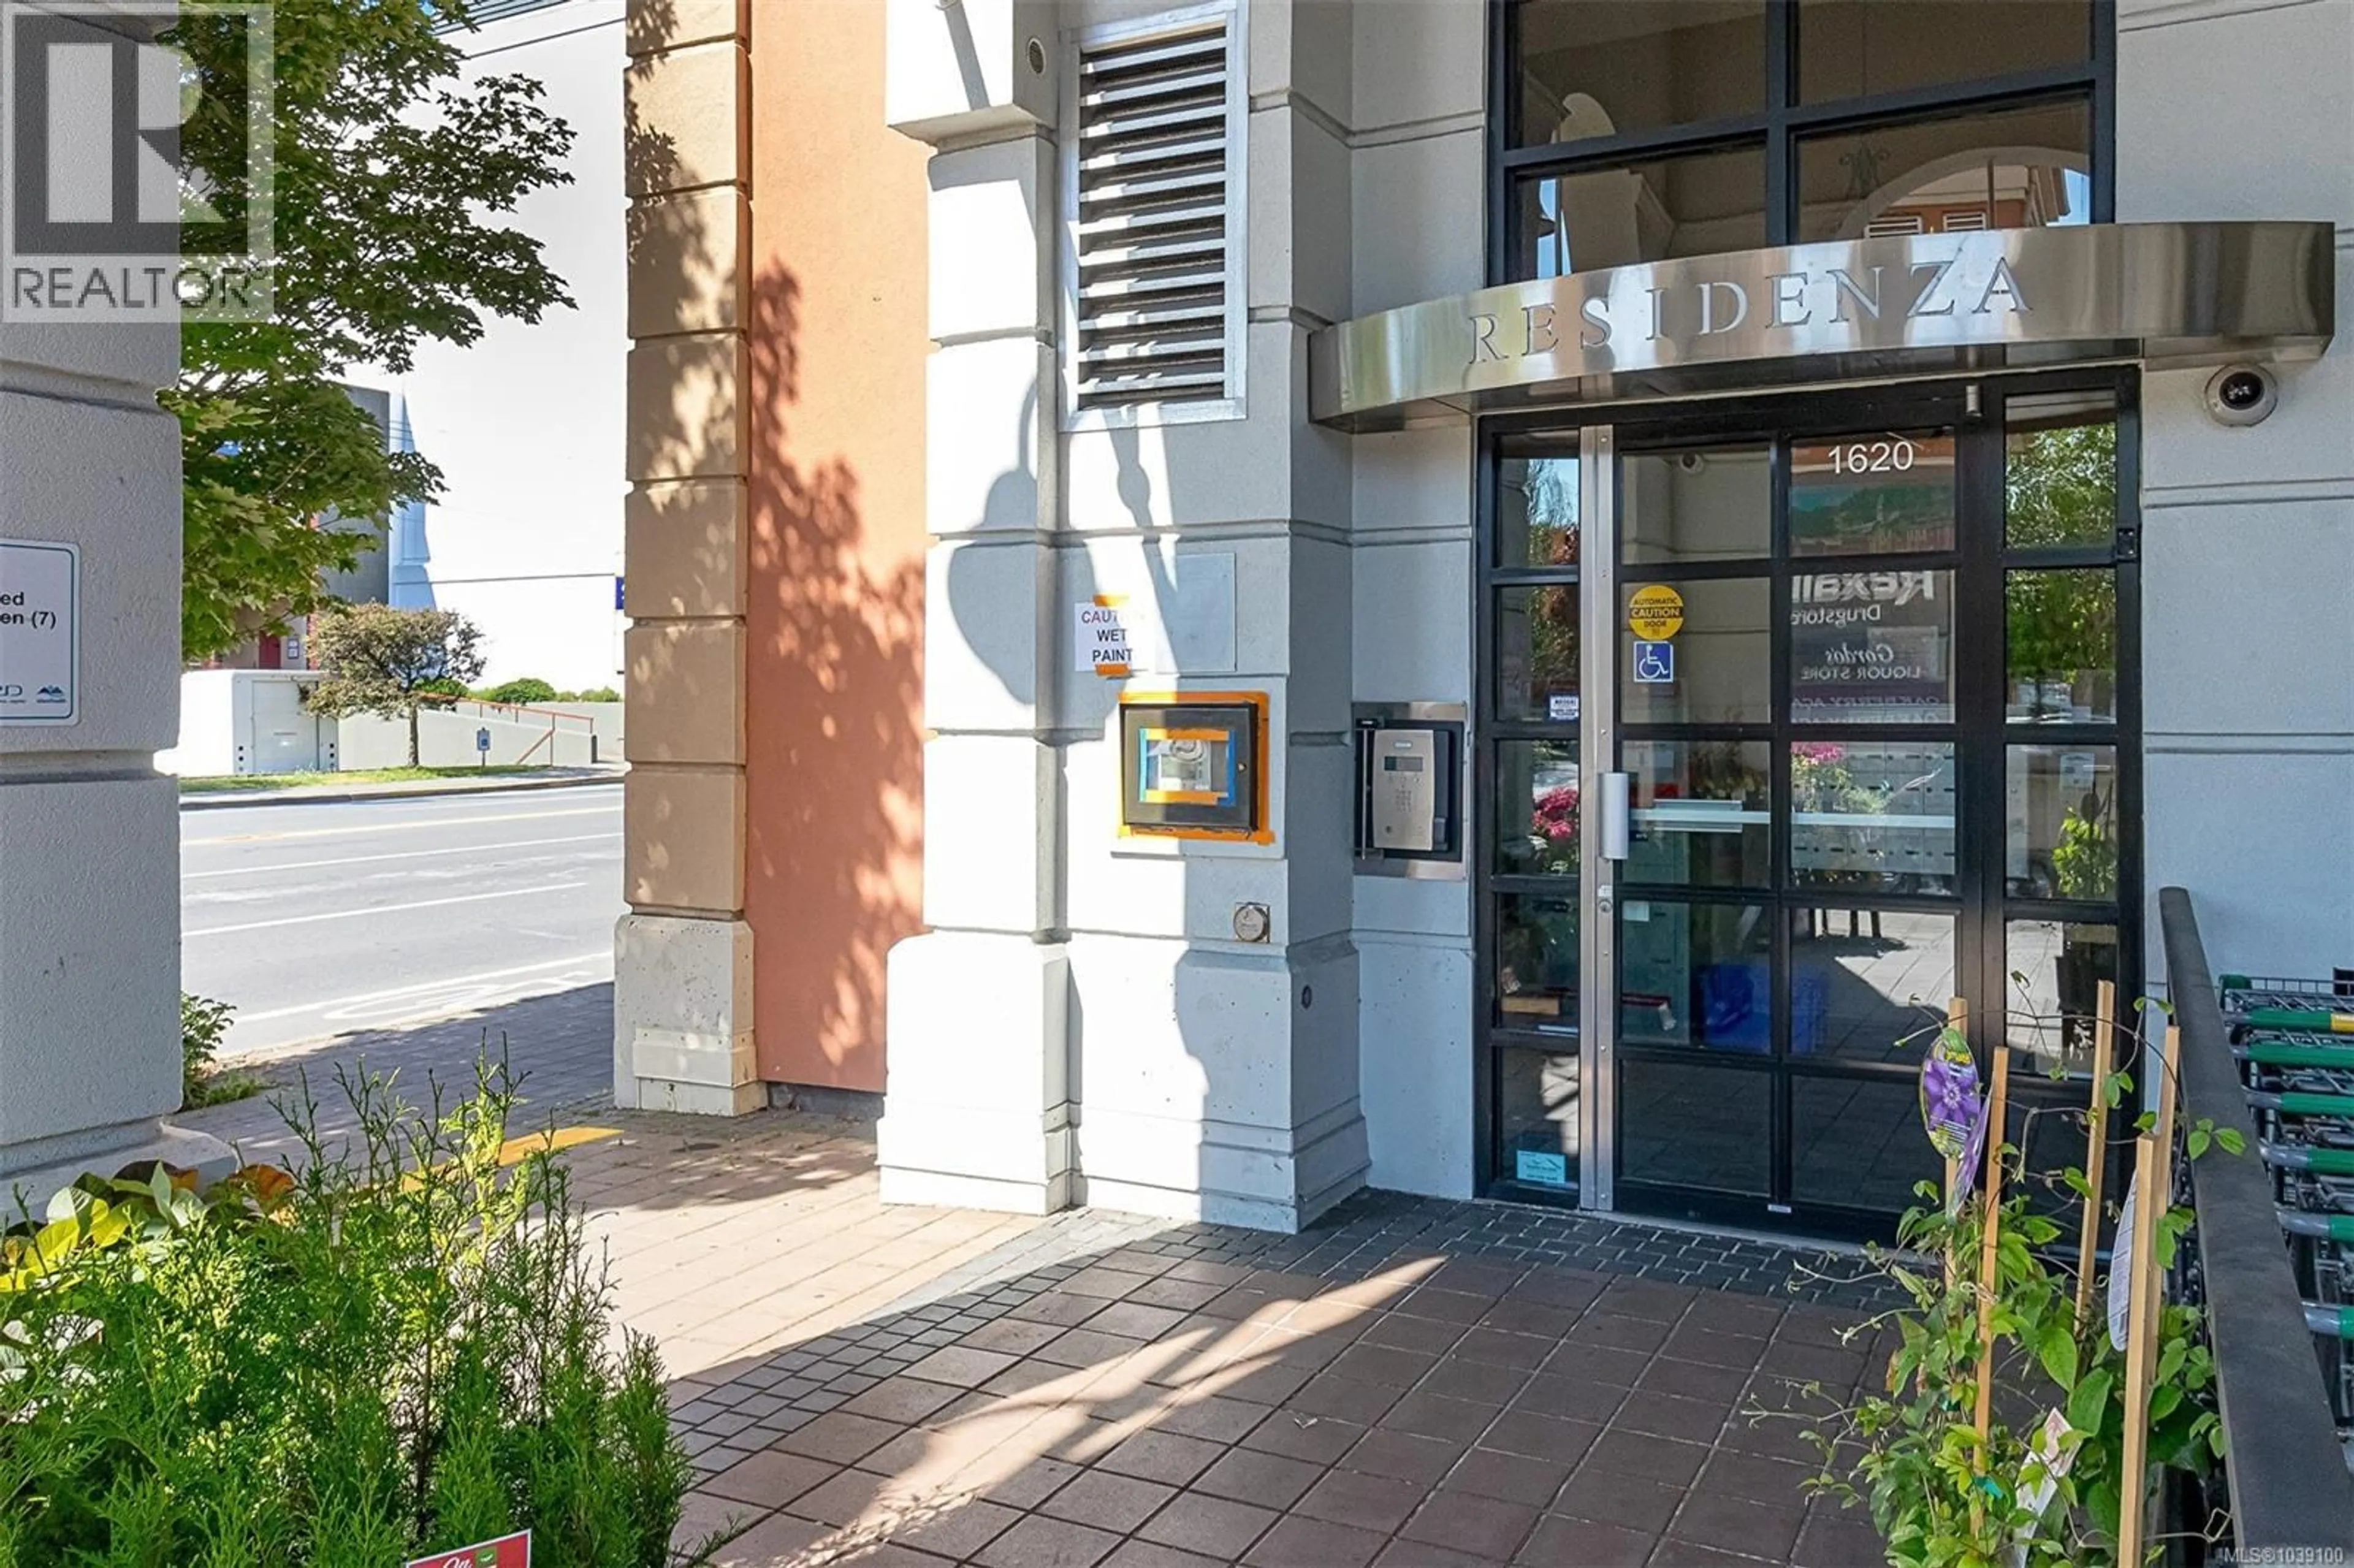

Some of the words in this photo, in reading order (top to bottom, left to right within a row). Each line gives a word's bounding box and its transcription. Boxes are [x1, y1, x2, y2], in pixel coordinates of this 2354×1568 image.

[1468, 254, 2034, 365] RESIDENZA
[1828, 441, 1914, 474] 1620
[32, 611, 56, 630] (7)
[1631, 608, 1680, 618] CAUTION
[1096, 628, 1127, 642] WET
[1092, 649, 1133, 662] PAINT
